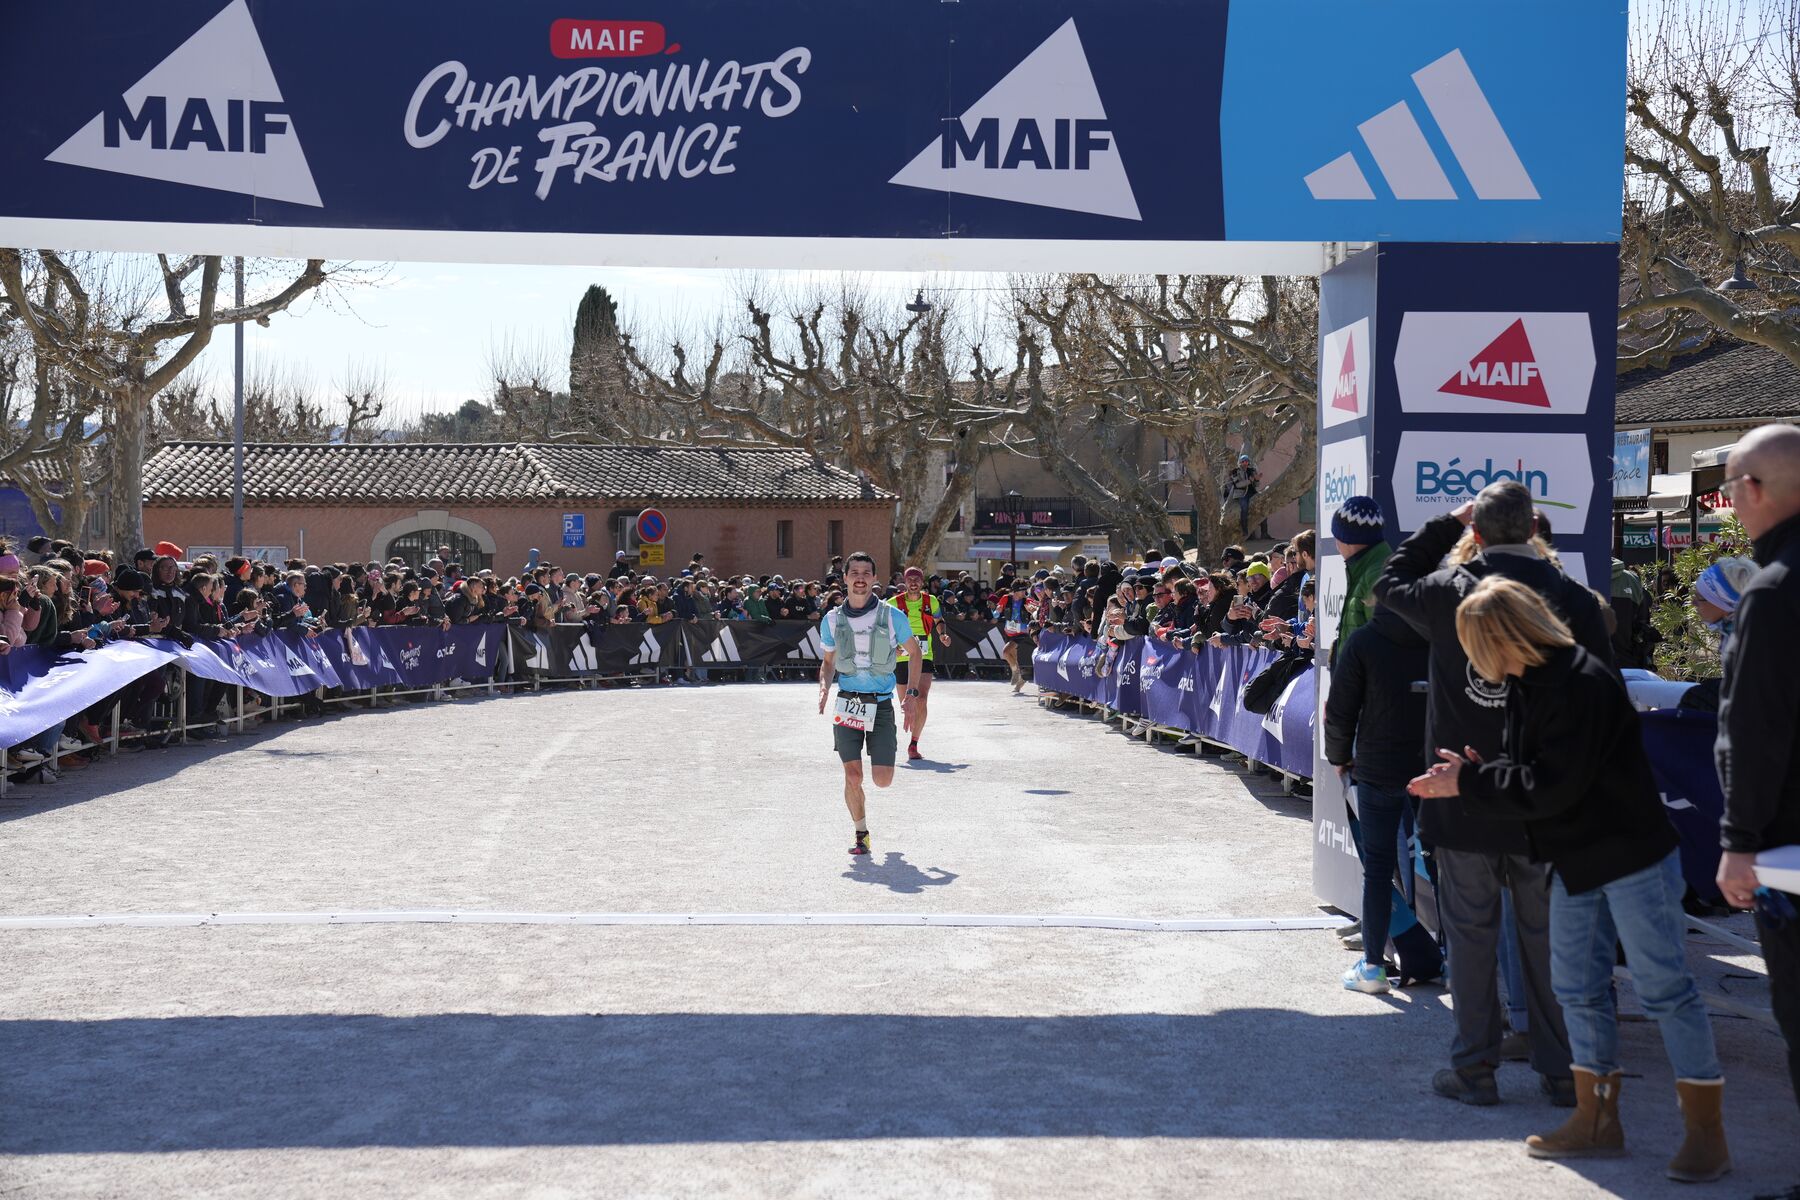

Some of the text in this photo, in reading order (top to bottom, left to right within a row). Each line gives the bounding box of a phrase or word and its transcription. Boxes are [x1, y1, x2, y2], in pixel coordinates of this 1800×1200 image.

[570, 28, 645, 51] MAIF
[403, 46, 812, 149] CHAMPIONNATS
[103, 95, 290, 154] MAIF
[941, 117, 1111, 170] MAIF
[468, 121, 742, 201] DE FRANCE
[1336, 371, 1358, 399] MAIF
[1460, 362, 1538, 386] MAIF
[1617, 433, 1649, 446] RESTAURANT
[1032, 511, 1053, 523] PIZZA
[1323, 577, 1346, 618] VAUC
[844, 700, 867, 716] 1274
